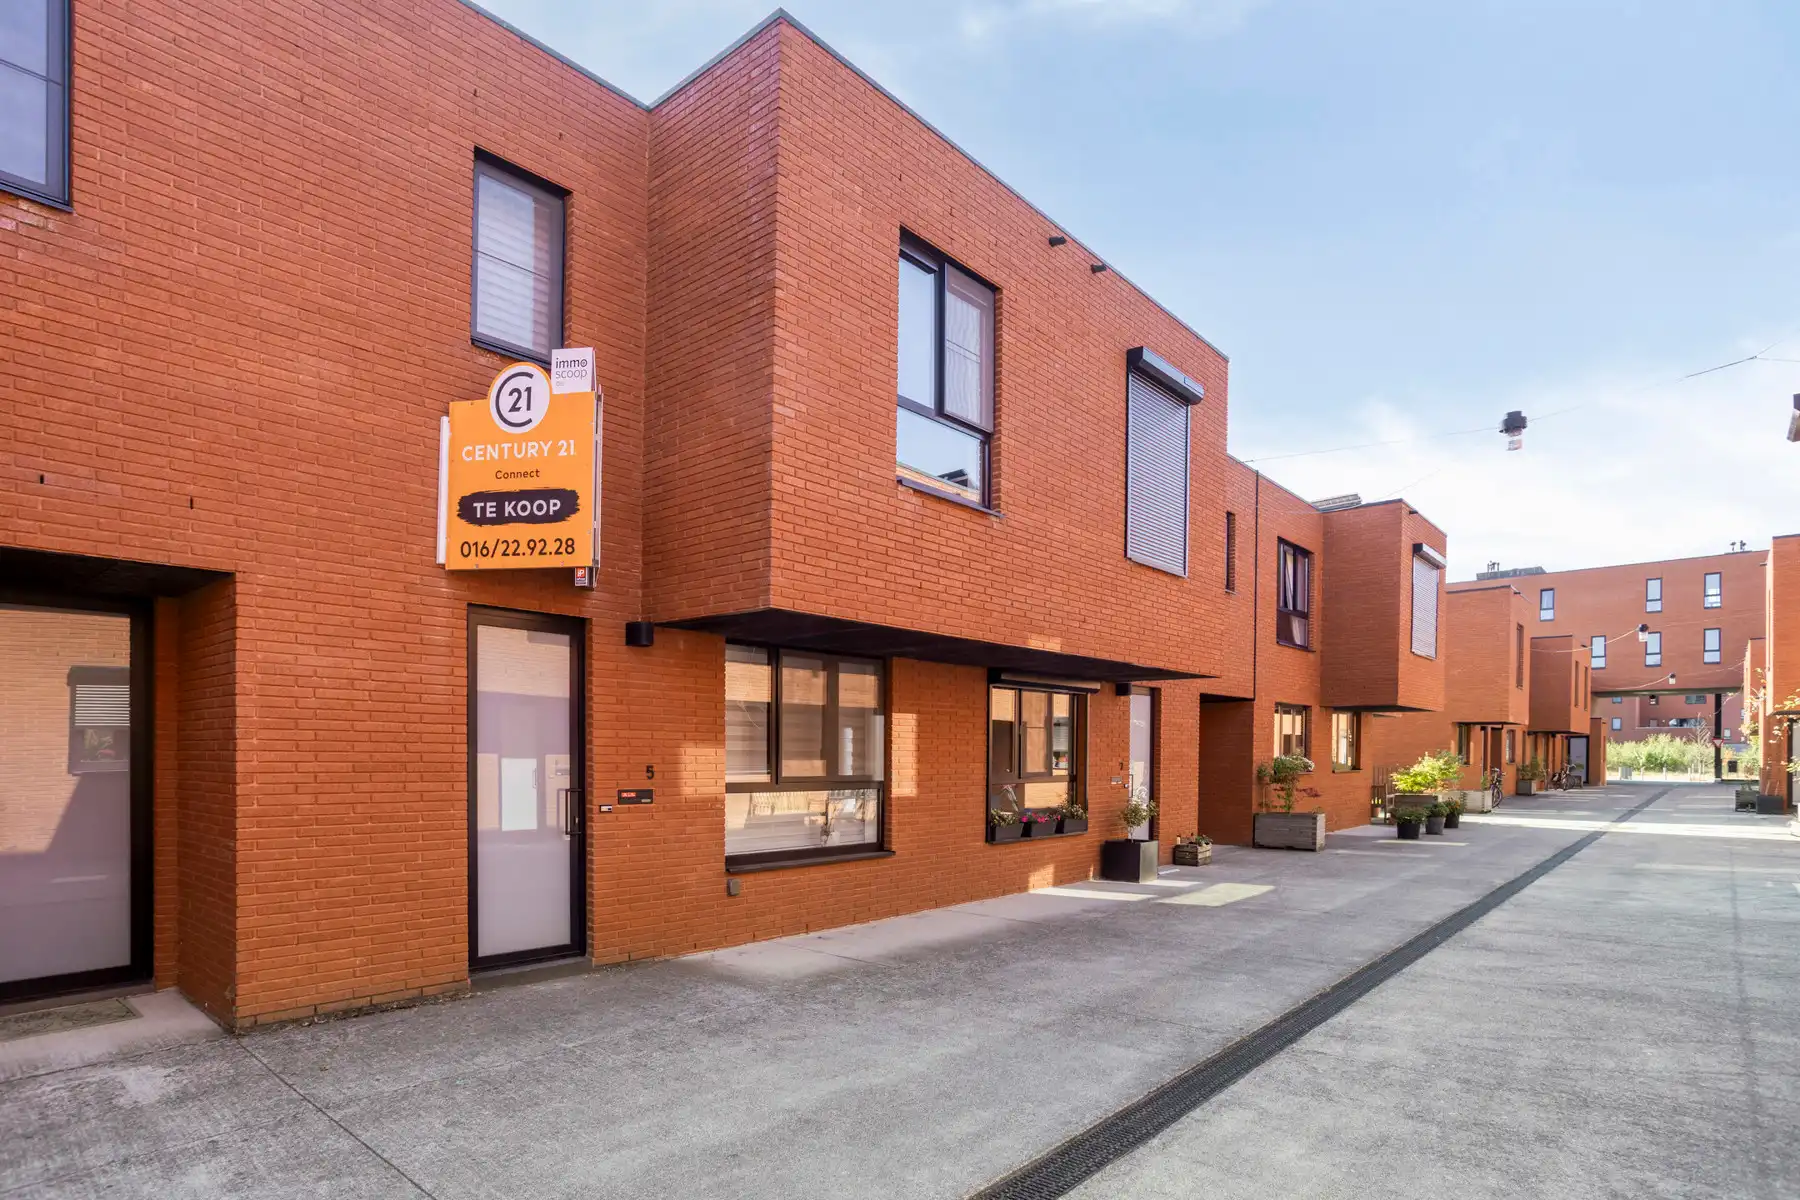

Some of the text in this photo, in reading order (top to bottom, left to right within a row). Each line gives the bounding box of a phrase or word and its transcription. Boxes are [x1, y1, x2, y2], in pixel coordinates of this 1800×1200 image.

[555, 357, 588, 369] immo
[555, 369, 588, 380] scoop
[462, 439, 576, 461] CENTURY 21
[495, 468, 541, 480] Connect
[473, 499, 561, 518] TE KOOP
[460, 537, 576, 559] 016/22.92.28
[646, 764, 655, 780] 5
